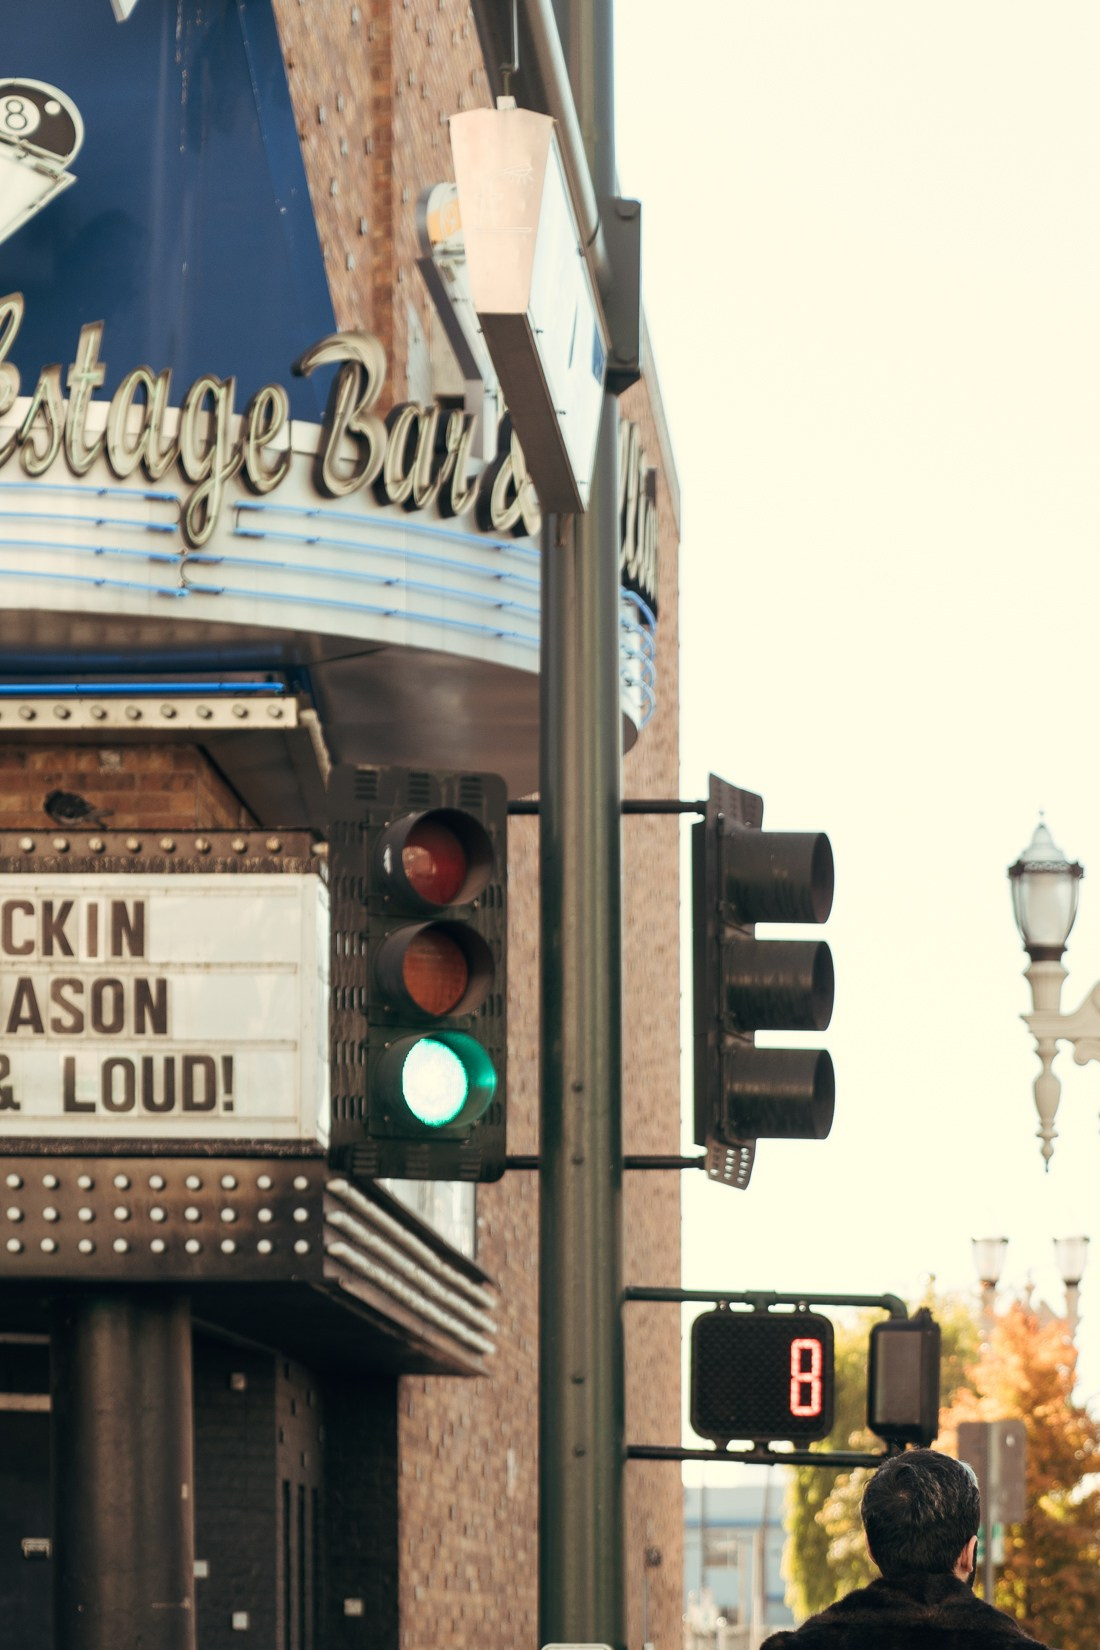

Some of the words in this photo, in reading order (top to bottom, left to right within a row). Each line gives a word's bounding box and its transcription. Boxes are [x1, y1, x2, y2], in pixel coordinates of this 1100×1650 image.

[5, 99, 27, 131] 8
[291, 330, 479, 518] Bar
[0, 899, 146, 958] CKIN
[5, 976, 169, 1036] ASON
[62, 1055, 235, 1114] LOUD!
[790, 1337, 823, 1418] 8
